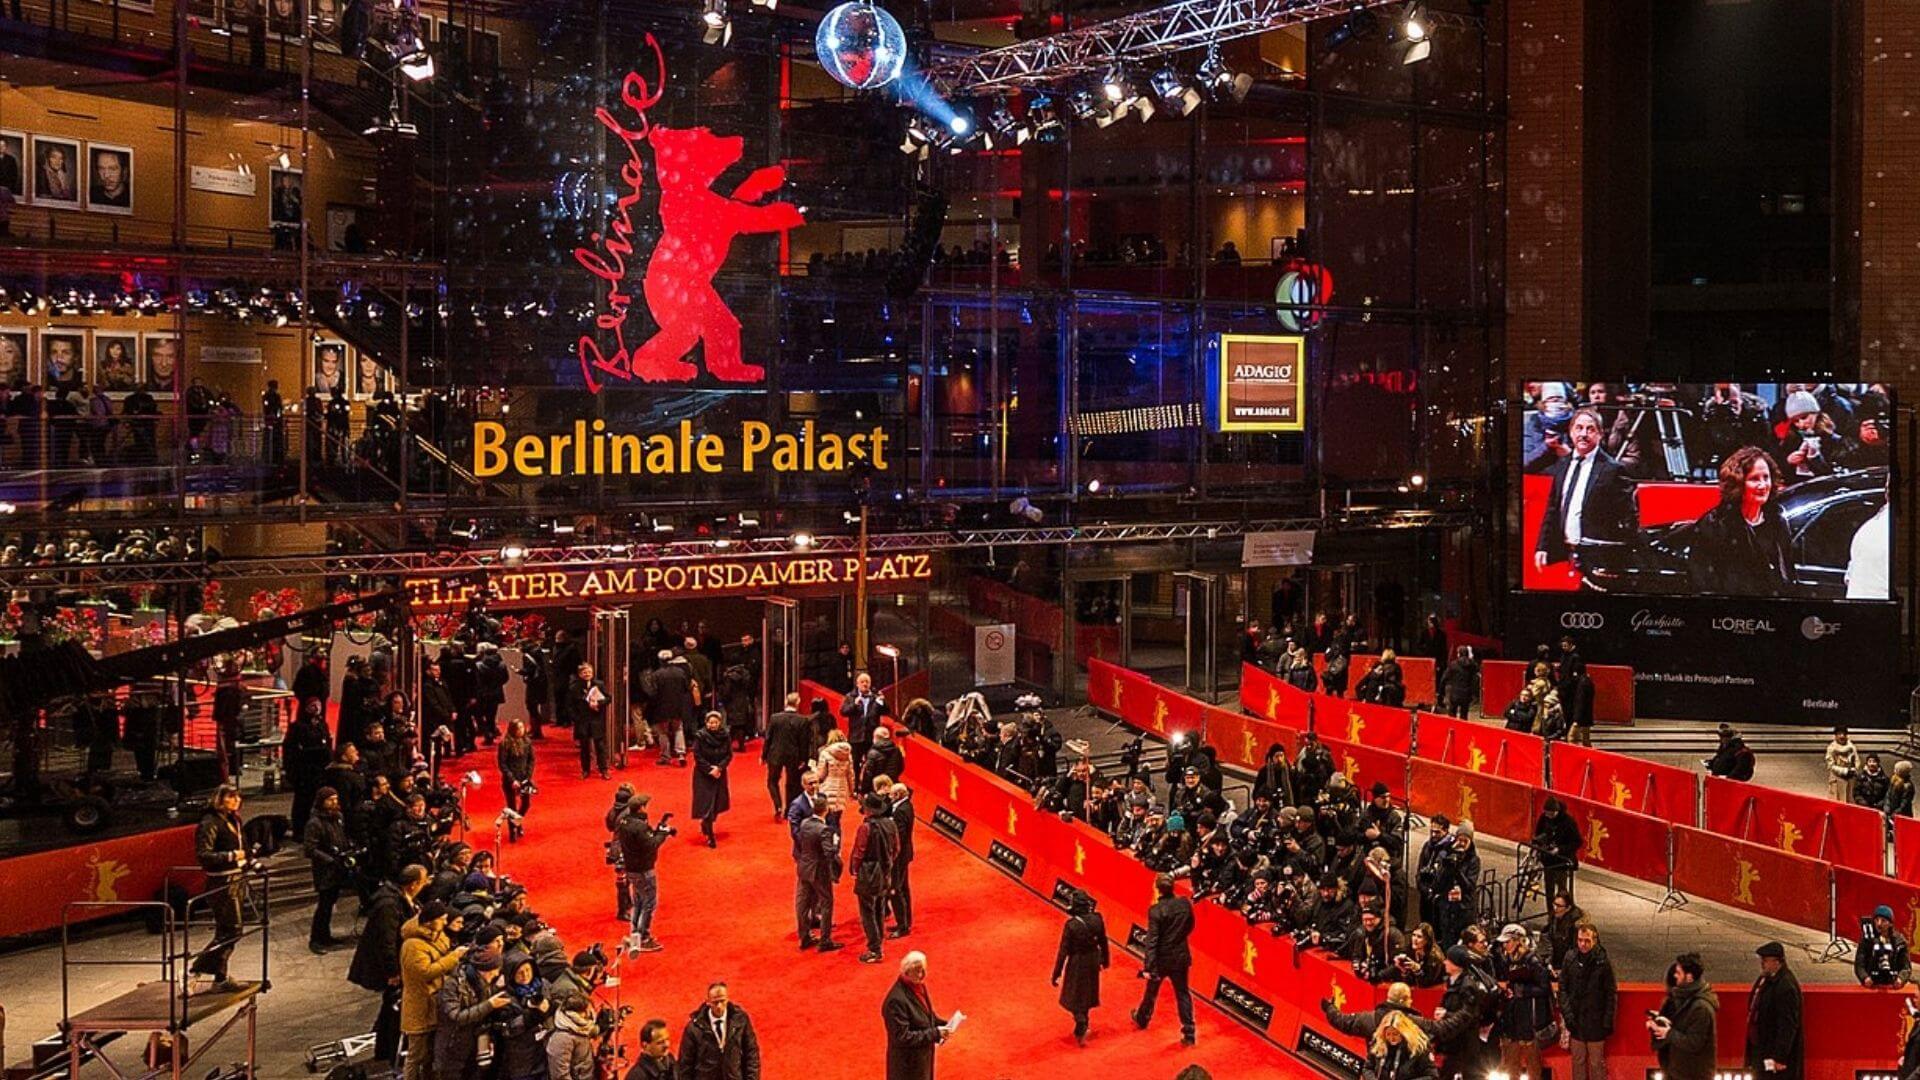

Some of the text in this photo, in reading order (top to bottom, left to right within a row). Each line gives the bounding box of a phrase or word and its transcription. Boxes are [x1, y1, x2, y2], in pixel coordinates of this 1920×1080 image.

[574, 32, 666, 394] Berlinale
[1233, 364, 1292, 378] ADAGIO
[473, 419, 889, 477] Berlinale Palast
[579, 568, 638, 595] AM
[645, 557, 838, 592] POTSDAMER
[1633, 671, 1653, 681] ishes
[1663, 672, 1683, 682] thank
[1694, 673, 1725, 685] Principal
[1725, 674, 1755, 686] Partners
